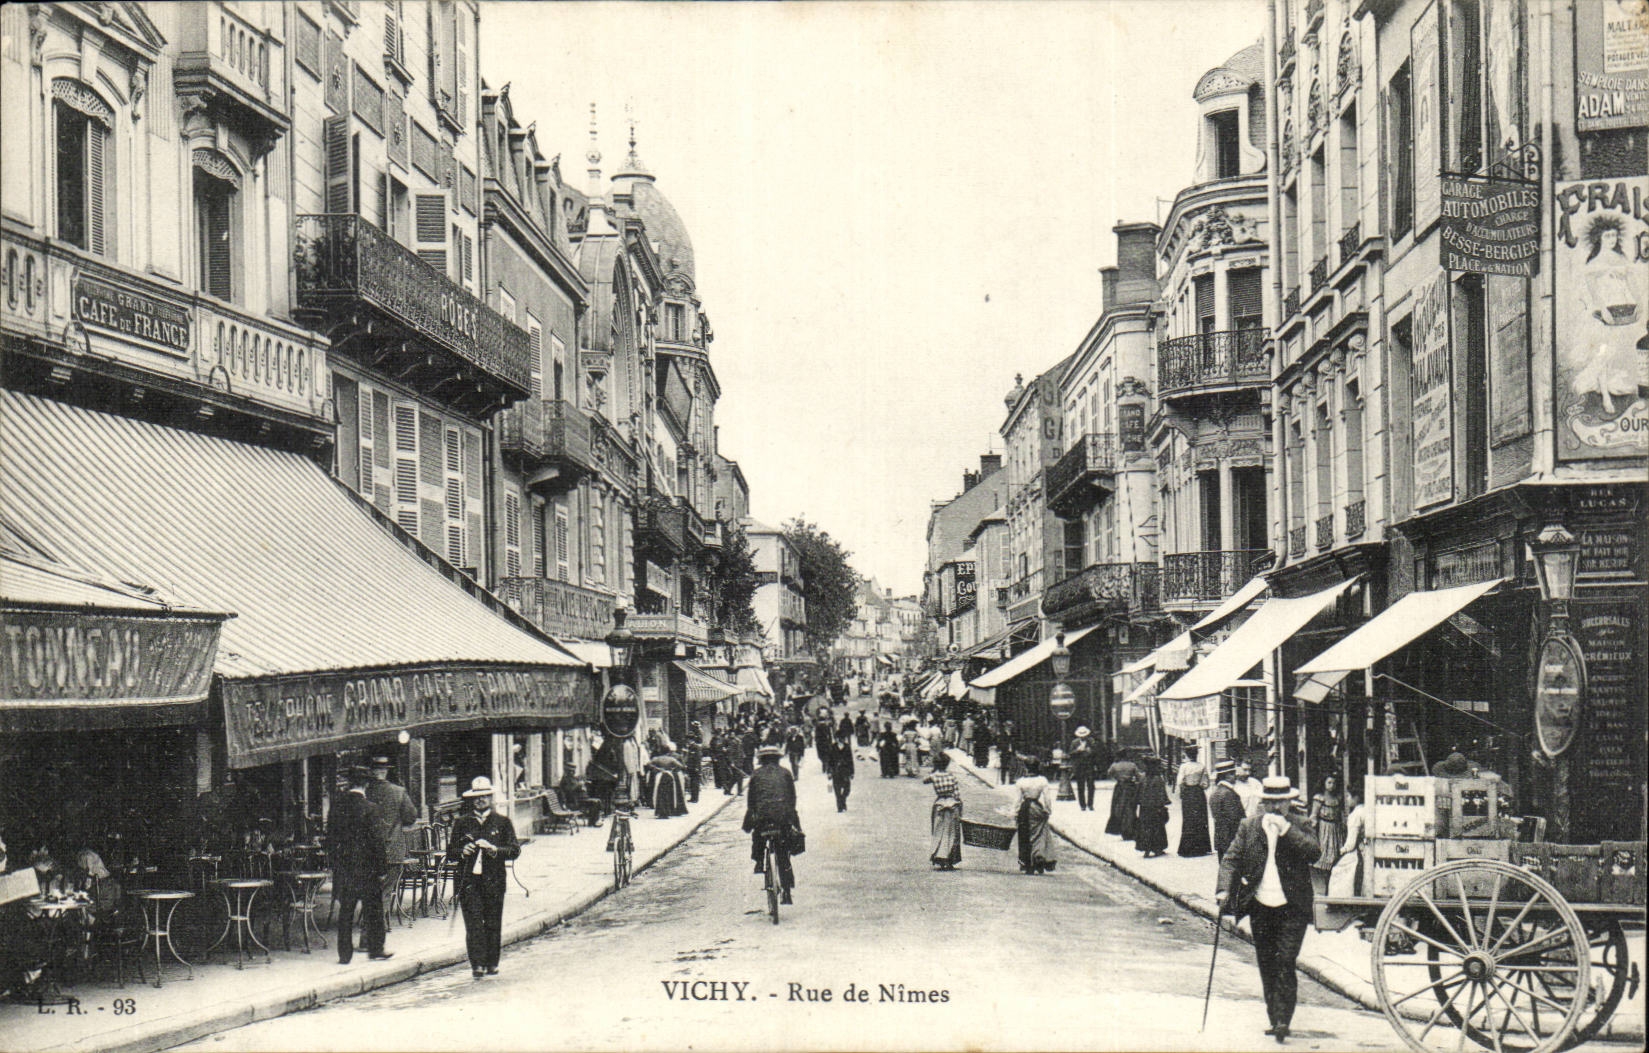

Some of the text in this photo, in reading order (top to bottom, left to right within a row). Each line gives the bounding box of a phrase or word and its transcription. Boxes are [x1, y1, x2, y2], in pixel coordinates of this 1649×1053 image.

[1578, 91, 1624, 118] ADAM
[1441, 190, 1539, 218] AUTOMOBILES
[1442, 182, 1483, 199] GARAGE
[1442, 226, 1539, 260] BESSE-BERGIER
[1449, 253, 1480, 271] PLACE
[1494, 262, 1531, 276] NATION
[118, 294, 154, 315] GRAND
[442, 292, 476, 340] ROBES
[80, 296, 118, 327] CAFE
[134, 313, 187, 347] FRANCE
[1580, 498, 1627, 508] LUCAS
[344, 677, 408, 730] GRAND
